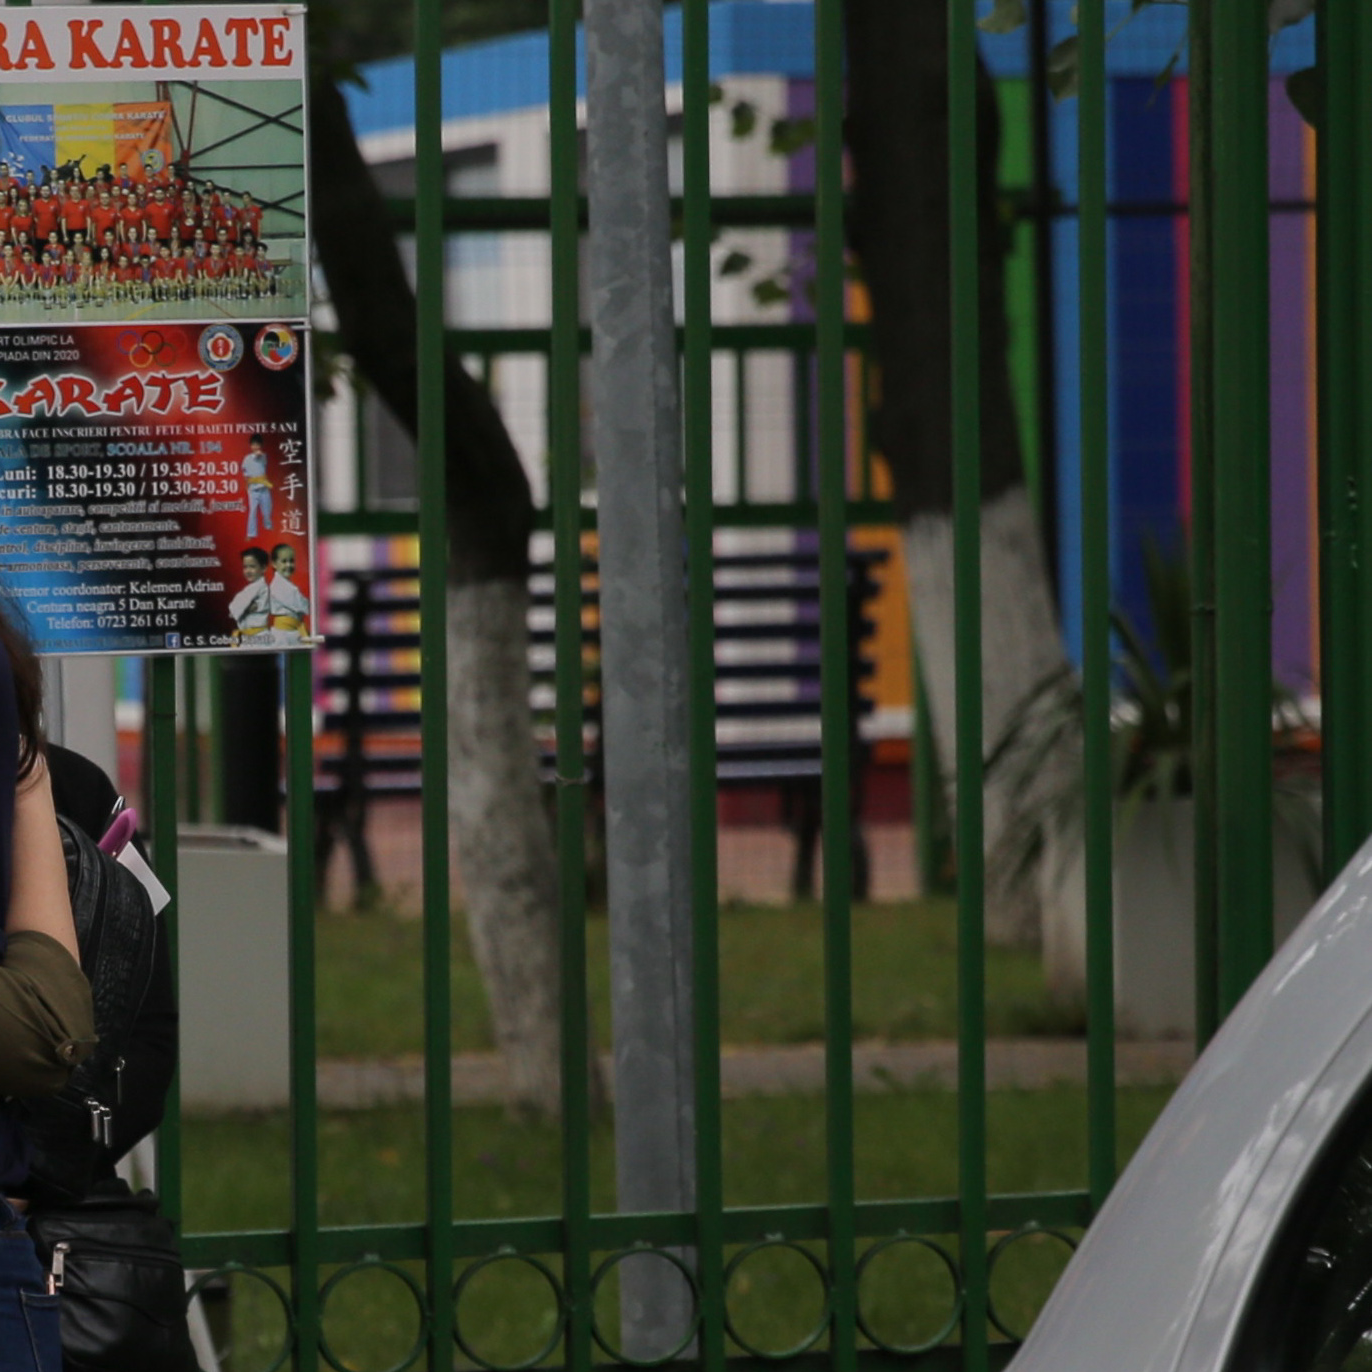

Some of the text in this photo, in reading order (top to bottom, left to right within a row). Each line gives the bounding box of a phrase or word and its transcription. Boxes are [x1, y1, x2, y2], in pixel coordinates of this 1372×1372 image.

[65, 17, 294, 69] KARATE
[12, 334, 58, 347] OLIMPIC
[59, 334, 75, 346] LA
[31, 350, 51, 361] DIN
[53, 348, 80, 361] 2020
[22, 428, 48, 439] FACE
[52, 427, 107, 439] INSCRIERI
[109, 425, 151, 437] PENTRU
[156, 424, 182, 436] FETE
[197, 423, 234, 435] BAIETI
[236, 422, 268, 434] PESTE
[270, 422, 277, 433] 5
[278, 422, 298, 433] ANI
[107, 441, 168, 457] SCOALA
[47, 464, 136, 480] 18.30-19.30
[139, 462, 147, 478] /
[151, 461, 239, 477] 19.30-20.30
[47, 483, 136, 499] 18.30-19.30
[139, 481, 147, 496] /
[151, 479, 239, 496] 19.30-20.30
[278, 438, 305, 537] 空手道
[52, 582, 127, 596] coordonator:
[129, 581, 183, 595] Kelemen
[184, 579, 225, 593] Adrian
[26, 597, 197, 615] Centura neagra 5 Dan Karate
[45, 613, 179, 630] Telefon: 0723 261 615
